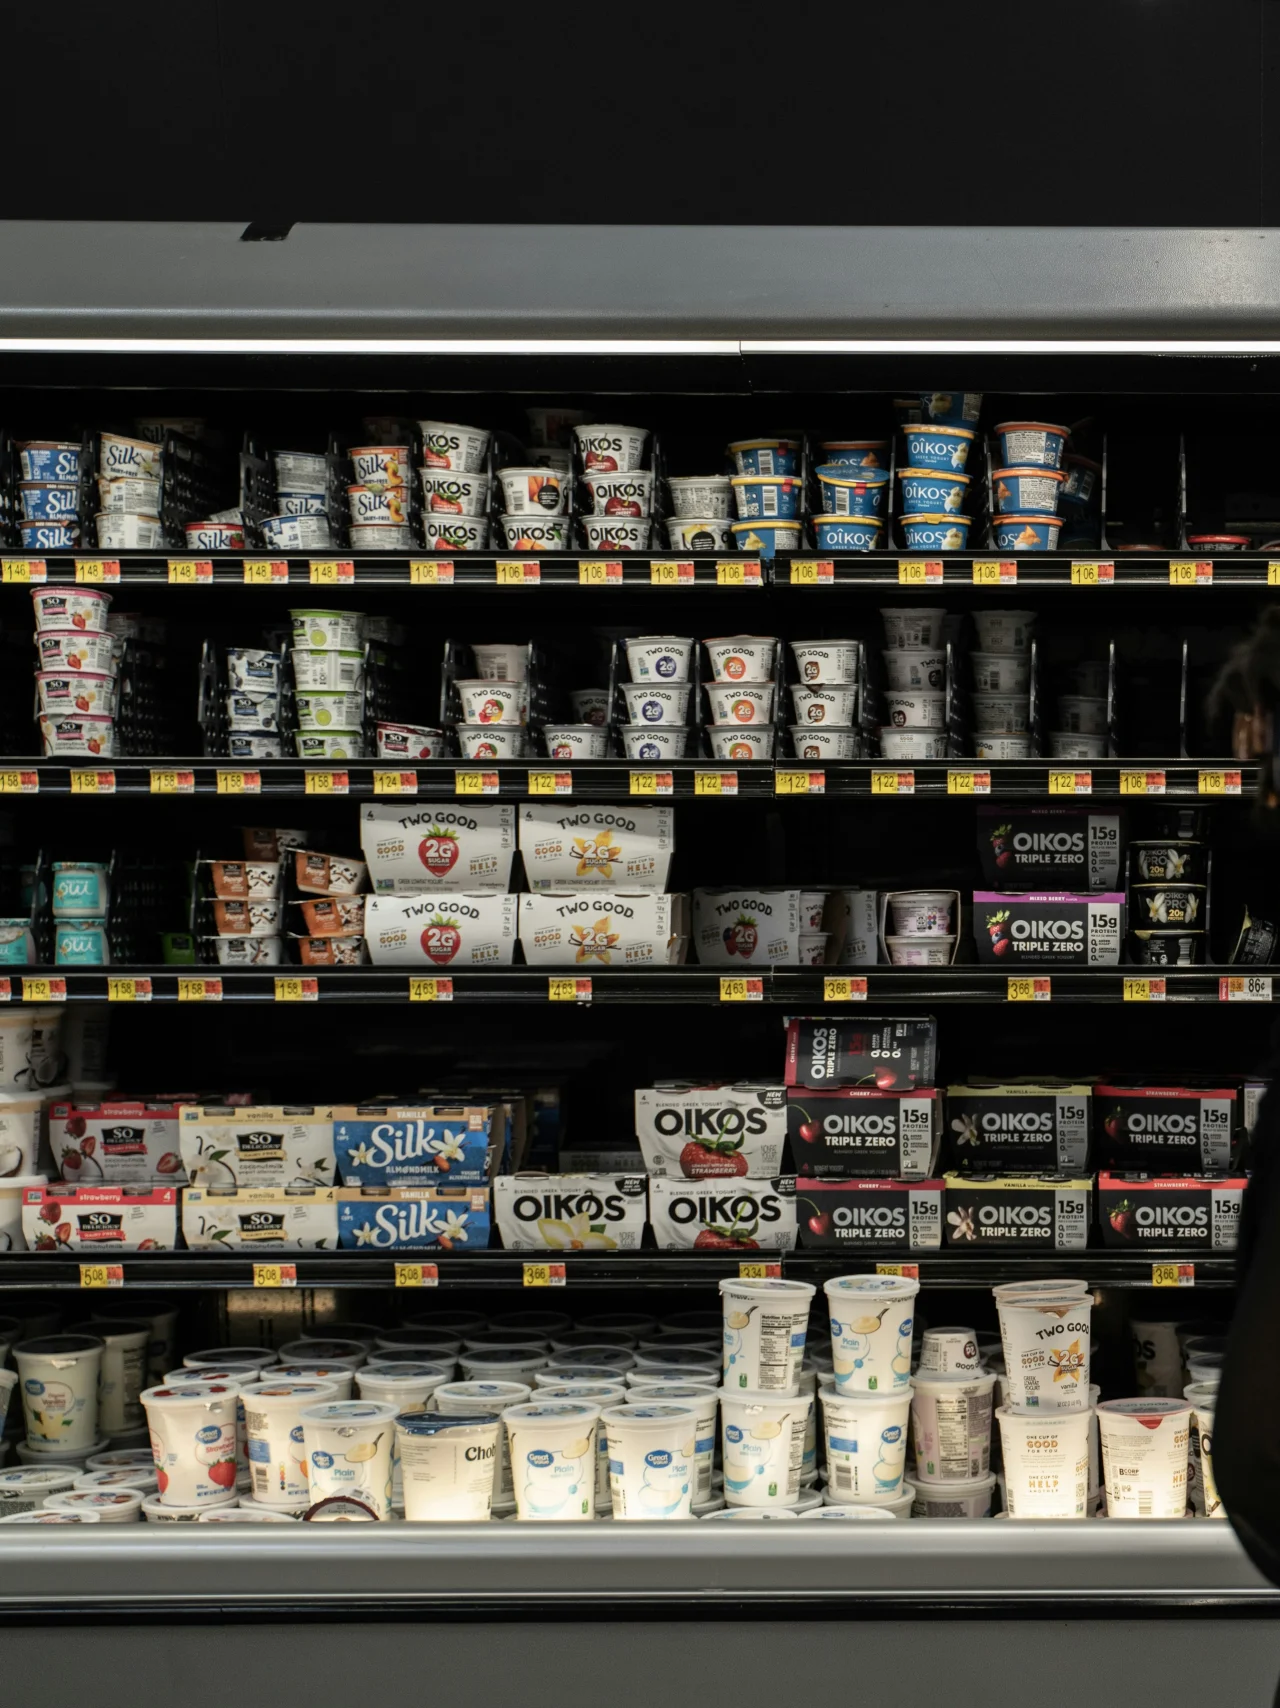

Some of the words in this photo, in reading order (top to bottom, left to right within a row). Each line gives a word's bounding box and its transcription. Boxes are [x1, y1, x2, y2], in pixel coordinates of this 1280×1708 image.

[580, 438, 622, 453] OIKOS
[106, 444, 140, 467] Silk
[358, 455, 385, 478] Silk
[425, 480, 471, 497] OIKOS
[596, 483, 644, 499] OIKOS
[358, 494, 387, 516] Silk
[428, 524, 477, 540] OIKOS
[507, 527, 555, 541] OIKOS
[590, 527, 638, 542] OIKOS
[645, 647, 663, 656] TWO
[664, 647, 684, 657] GOOD
[717, 648, 733, 657] TWO
[735, 648, 754, 657] GOOD
[472, 691, 489, 700] TWO
[490, 690, 512, 700] GOOD
[633, 692, 650, 701] TWO
[651, 691, 672, 701] GOOD
[725, 692, 742, 701] TWO
[743, 691, 763, 700] GOOD
[398, 812, 431, 829] TWO
[435, 812, 477, 831] GOOD
[557, 816, 591, 831] TWO
[594, 812, 636, 833] GOOD
[1091, 826, 1116, 842] 15g
[1013, 832, 1084, 853] OIKOS
[471, 860, 498, 872] HELP
[1015, 854, 1051, 864] TRIPLE
[1053, 853, 1084, 864] ZERO
[627, 862, 655, 874] HELP
[526, 900, 532, 909] 4
[556, 903, 590, 918] TWO
[593, 900, 633, 919] GOOD
[715, 902, 742, 916] TWO
[743, 899, 773, 916] GOOD
[1165, 899, 1188, 910] PRO
[1091, 914, 1117, 930] 15g
[534, 932, 562, 943] GOOD
[1010, 920, 1084, 940] OIKOS
[626, 948, 653, 959] HELP
[1012, 941, 1050, 952] TRIPLE
[1052, 941, 1084, 952] ZERO
[828, 1028, 837, 1050] ZERO
[811, 1027, 828, 1079] OIKOS
[826, 1052, 835, 1078] TRIPLE
[247, 1112, 274, 1120] vanilla
[396, 1111, 426, 1119] VANILLA
[654, 1108, 767, 1135] OIKOS
[903, 1109, 929, 1124] 15g
[982, 1112, 1053, 1131] OIKOS
[1059, 1106, 1085, 1122] 15g
[824, 1114, 897, 1135] OIKOS
[1127, 1113, 1196, 1133] OIKOS
[249, 1133, 271, 1144] SO
[365, 1120, 438, 1167] Silk
[825, 1136, 861, 1147] TRIPLE
[864, 1136, 896, 1147] ZERO
[984, 1133, 1019, 1143] TRIPLE
[1022, 1132, 1052, 1143] ZERO
[691, 1167, 737, 1175] STRAWBERRY
[79, 1194, 121, 1203] strawberry
[513, 1195, 625, 1222] OIKOS
[668, 1195, 781, 1223] OIKOS
[979, 1206, 1051, 1225] OIKOS
[1135, 1206, 1208, 1225] OIKOS
[89, 1213, 110, 1224] SO
[373, 1201, 436, 1248] Silk
[980, 1227, 1017, 1237] TRIPLE
[1020, 1227, 1051, 1237] ZERO
[1137, 1228, 1174, 1238] TRIPLE
[1176, 1227, 1207, 1237] ZERO
[1036, 1326, 1065, 1341] TWO
[1066, 1322, 1089, 1335] GOOD
[1027, 1440, 1058, 1448] GOOD
[528, 1453, 551, 1462] Great
[554, 1464, 574, 1474] Plain
[1028, 1480, 1059, 1488] HELP
